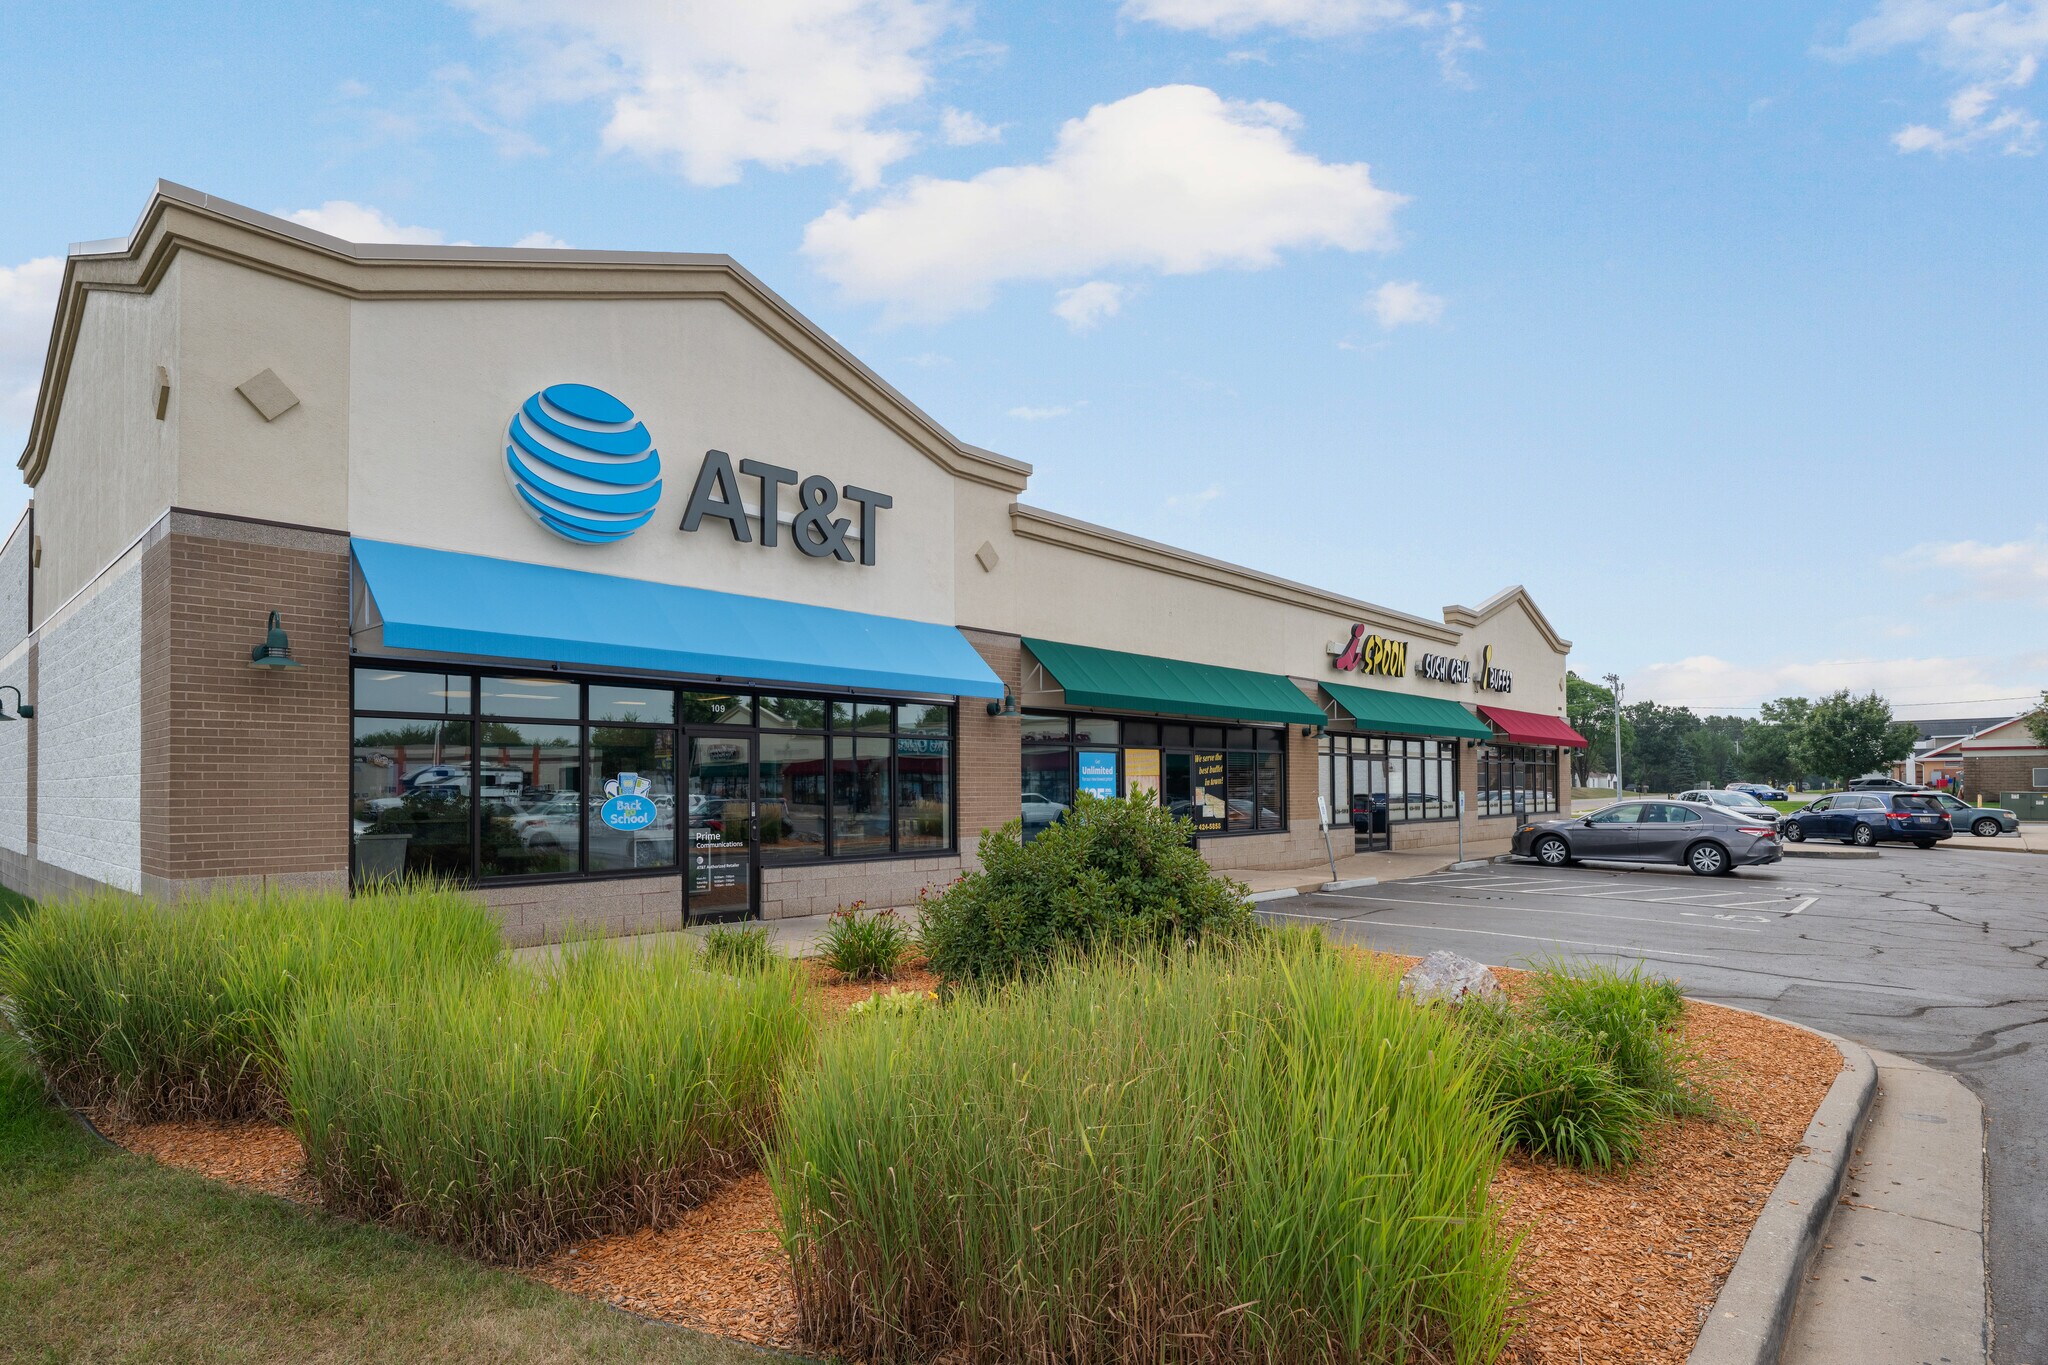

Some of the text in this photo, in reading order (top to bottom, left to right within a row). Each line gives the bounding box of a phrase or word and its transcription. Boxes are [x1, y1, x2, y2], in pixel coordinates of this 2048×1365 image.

[679, 449, 893, 567] AT&T
[1361, 634, 1408, 677] SPOON
[1422, 653, 1471, 684] SUSHI GRILL
[1488, 667, 1513, 693] BUFFET
[711, 704, 726, 713] 109
[1082, 766, 1114, 775] Unlimited
[617, 800, 642, 811] Back
[625, 808, 637, 817] to
[611, 813, 649, 825] School
[697, 832, 721, 841] Prime
[696, 841, 743, 849] Communications
